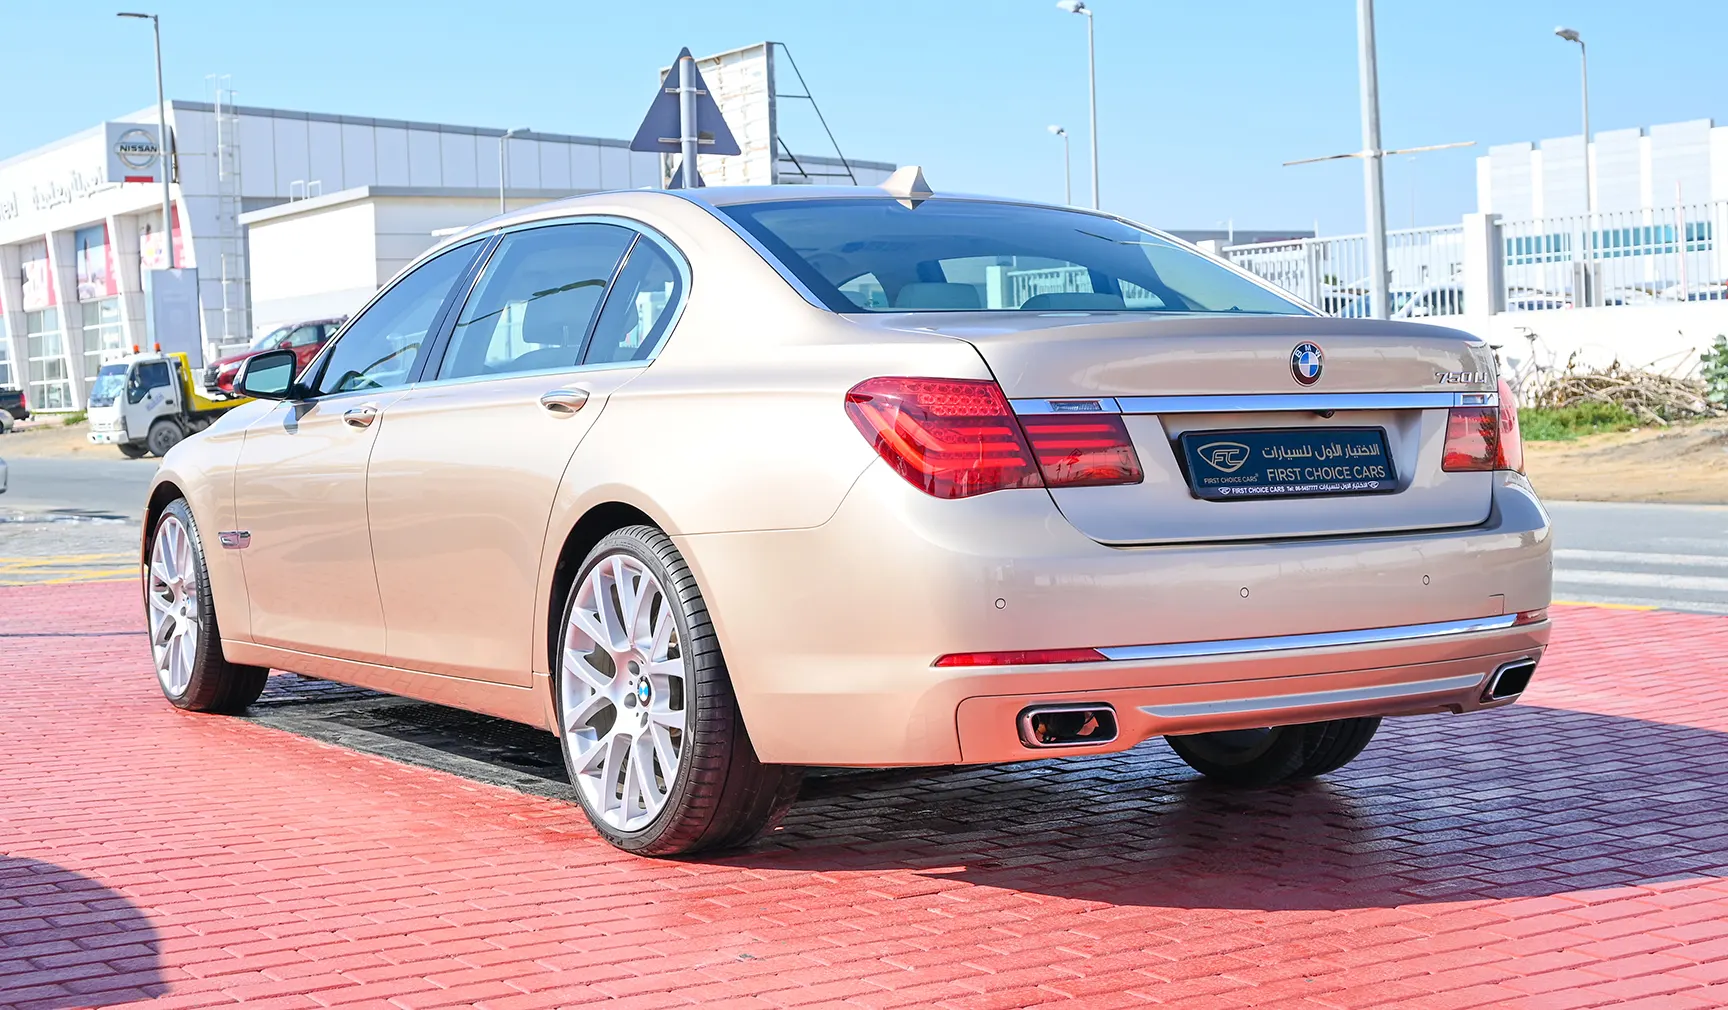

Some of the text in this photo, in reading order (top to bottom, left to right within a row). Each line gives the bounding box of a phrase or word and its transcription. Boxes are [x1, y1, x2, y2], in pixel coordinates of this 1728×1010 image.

[120, 144, 157, 152] NISSAN
[1294, 344, 1321, 358] BMW
[1262, 442, 1380, 461] الاختيار الأول للسيارات
[1266, 465, 1386, 481] FIRST CHOICE CARS
[1269, 485, 1285, 493] CARS
